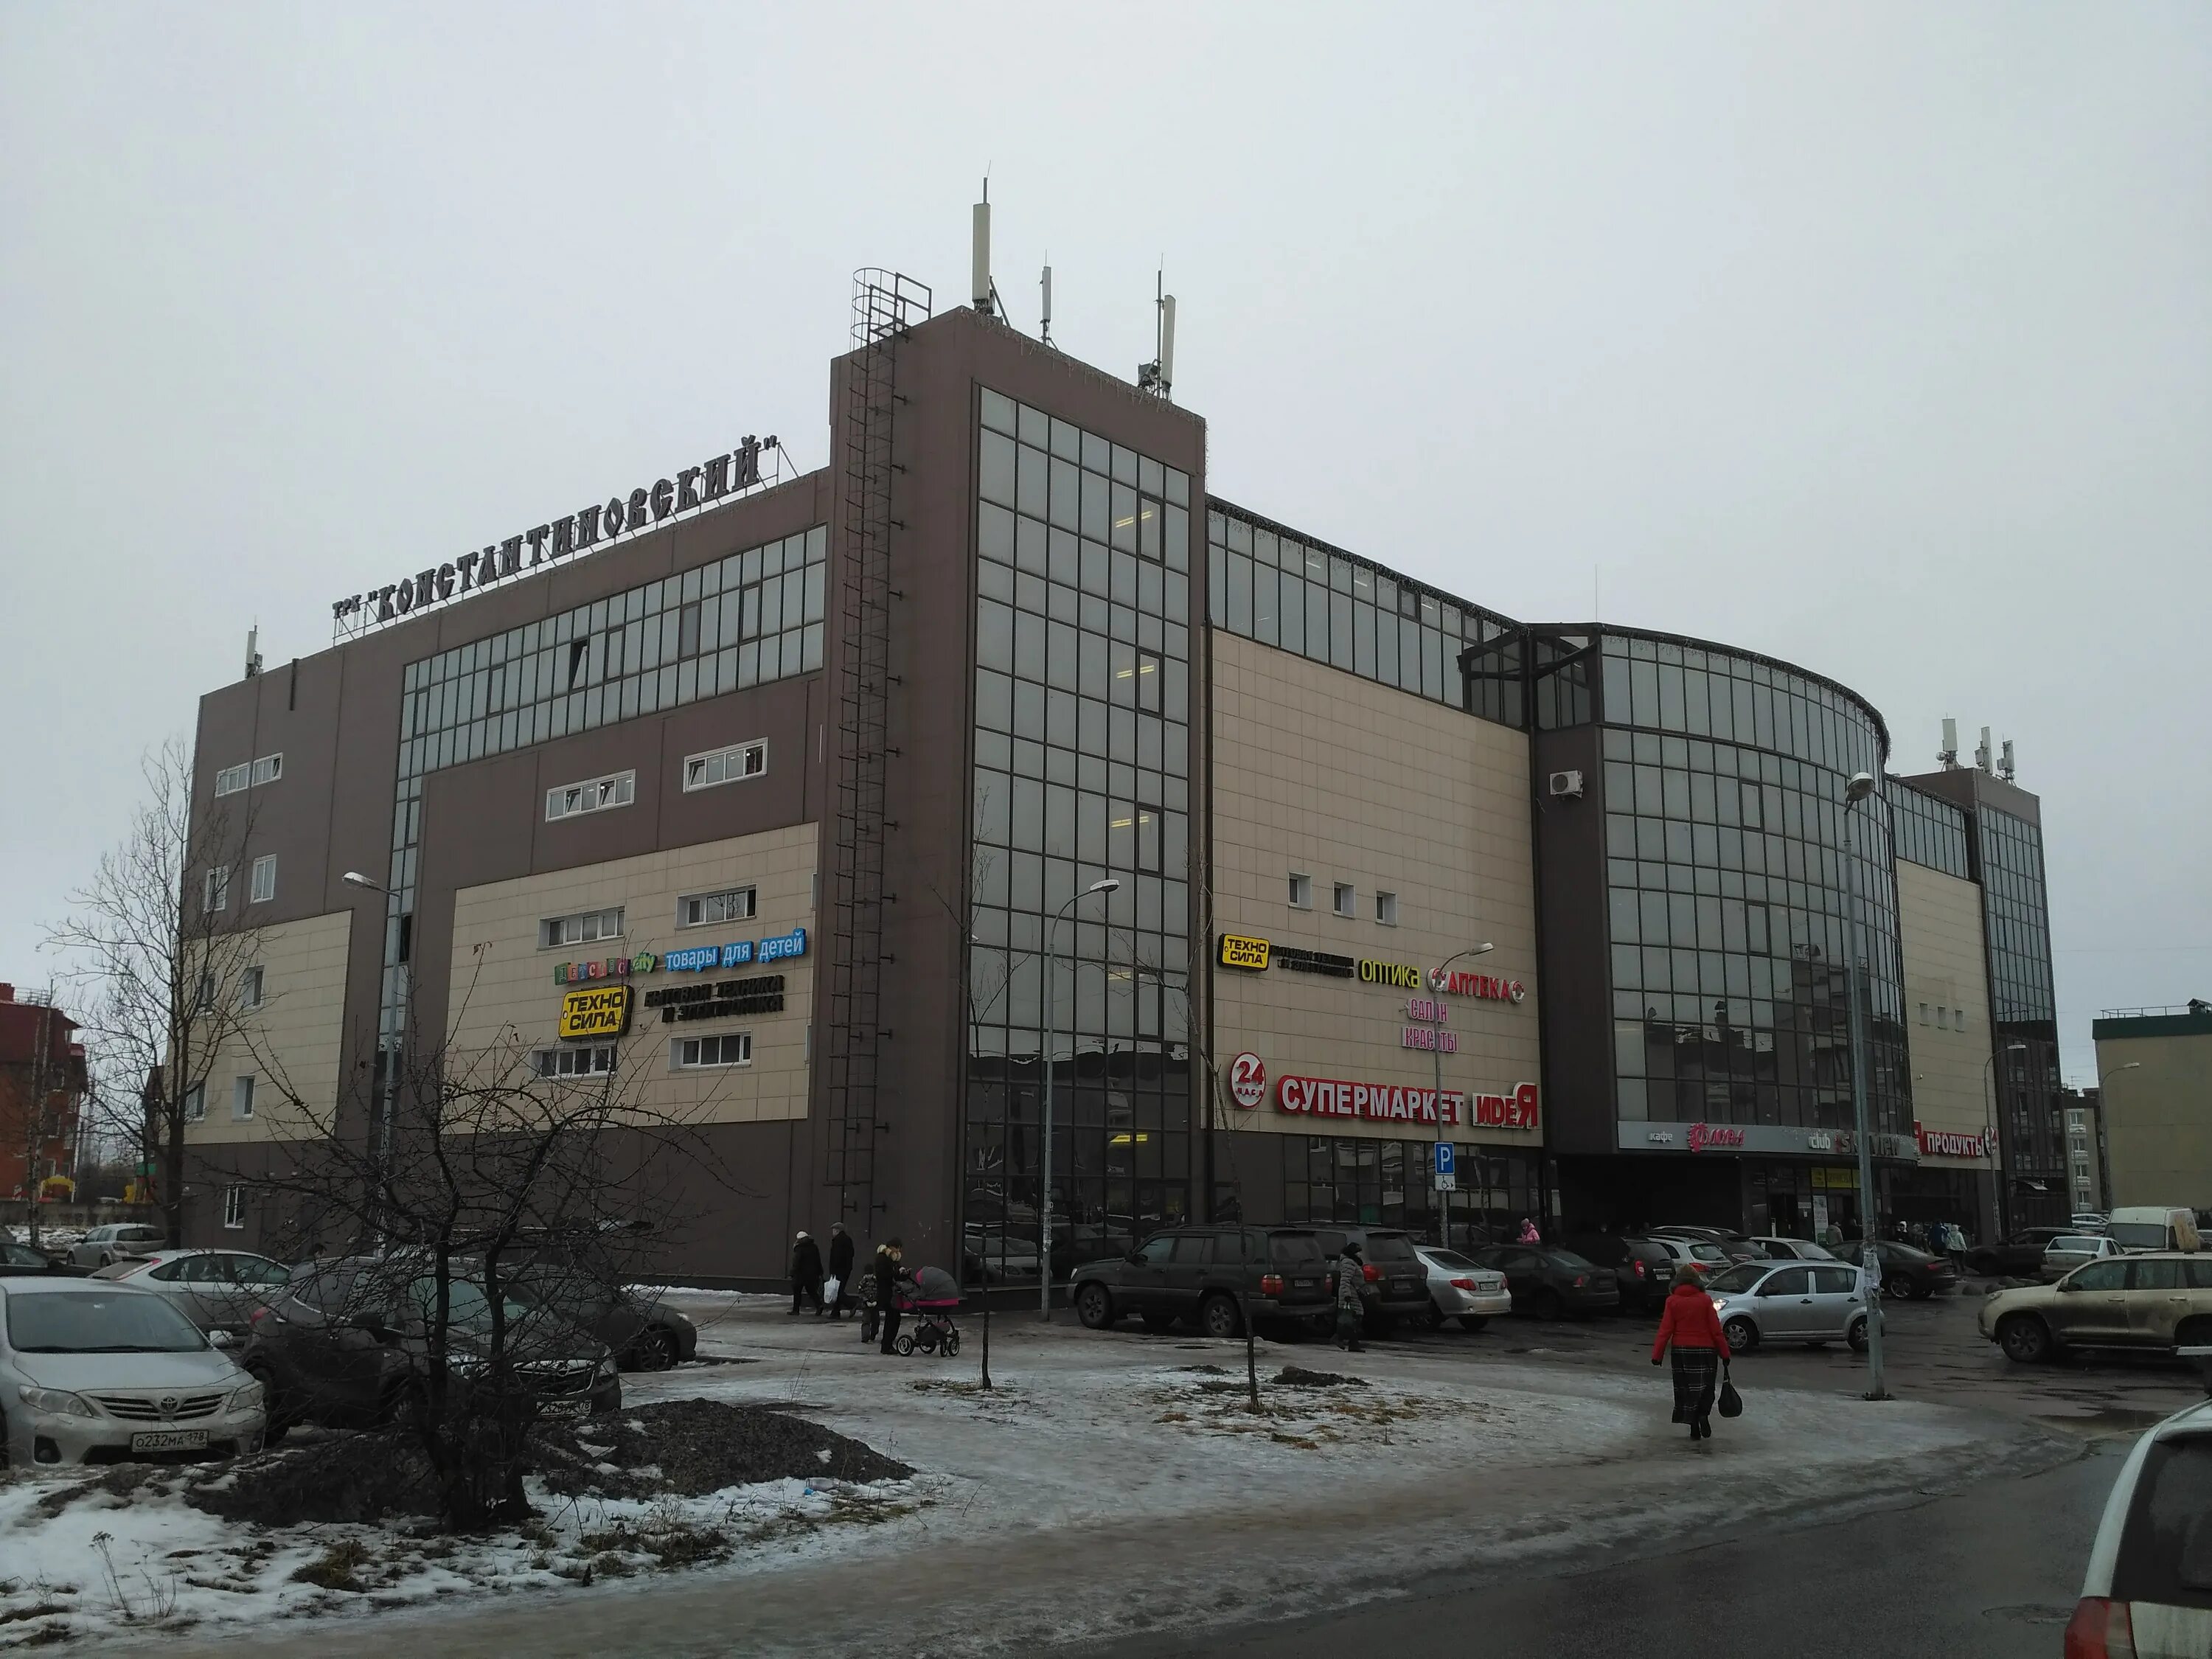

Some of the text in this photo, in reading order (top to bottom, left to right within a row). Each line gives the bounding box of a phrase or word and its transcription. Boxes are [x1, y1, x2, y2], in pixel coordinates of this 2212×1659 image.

[666, 931, 803, 970] товары для детей
[1228, 939, 1267, 953] ТЕХНО
[1230, 950, 1263, 964] СИЛА
[1447, 971, 1511, 999] АПТЕКА
[568, 992, 623, 1013] ТЕХНО
[570, 1010, 616, 1031] СИЛА
[1237, 1060, 1265, 1085] 24
[1281, 1079, 1464, 1123] СУПЕРМАРКЕТ
[1649, 1131, 1673, 1143] кафе
[1809, 1133, 1831, 1150] club
[1927, 1133, 1984, 1157] ПРОДУКТЫ
